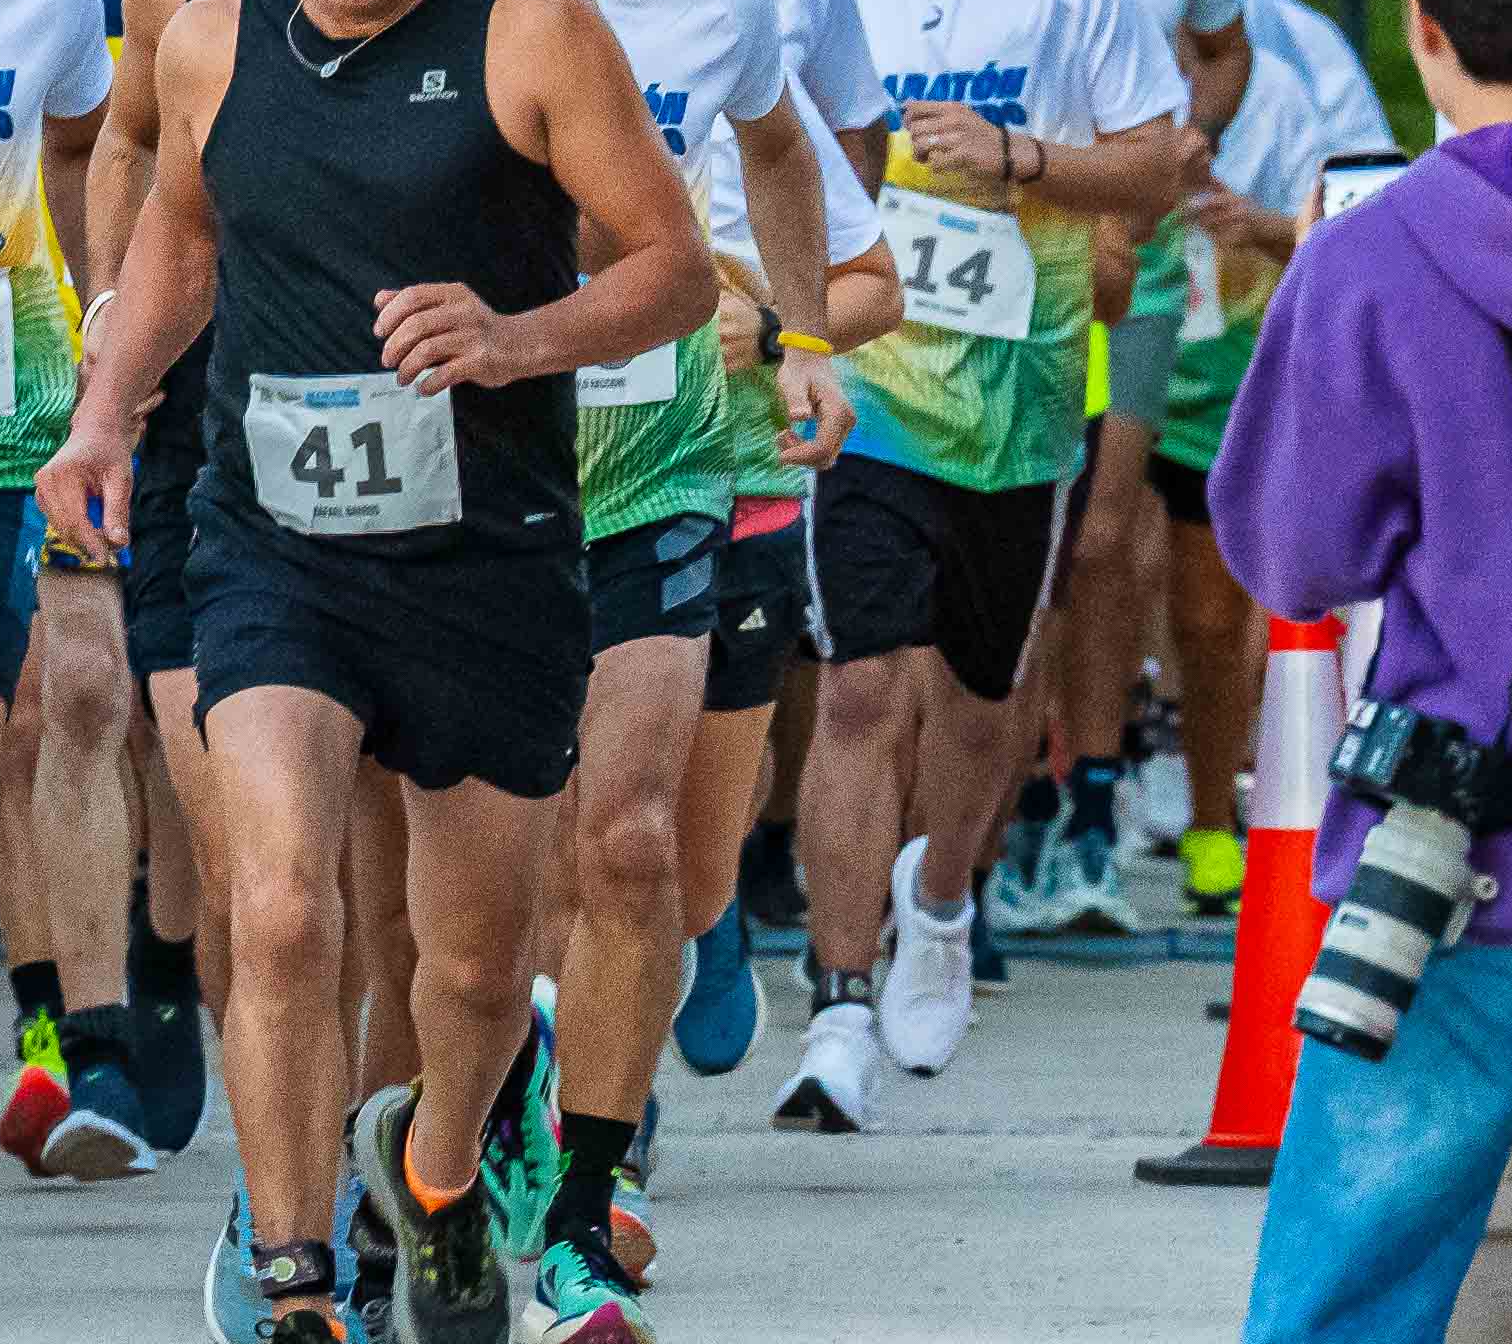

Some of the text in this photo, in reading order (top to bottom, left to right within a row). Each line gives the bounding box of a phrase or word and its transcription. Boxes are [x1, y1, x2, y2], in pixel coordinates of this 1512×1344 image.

[883, 60, 1028, 101] ARATÓN
[904, 235, 994, 305] 14
[289, 421, 403, 499] 41
